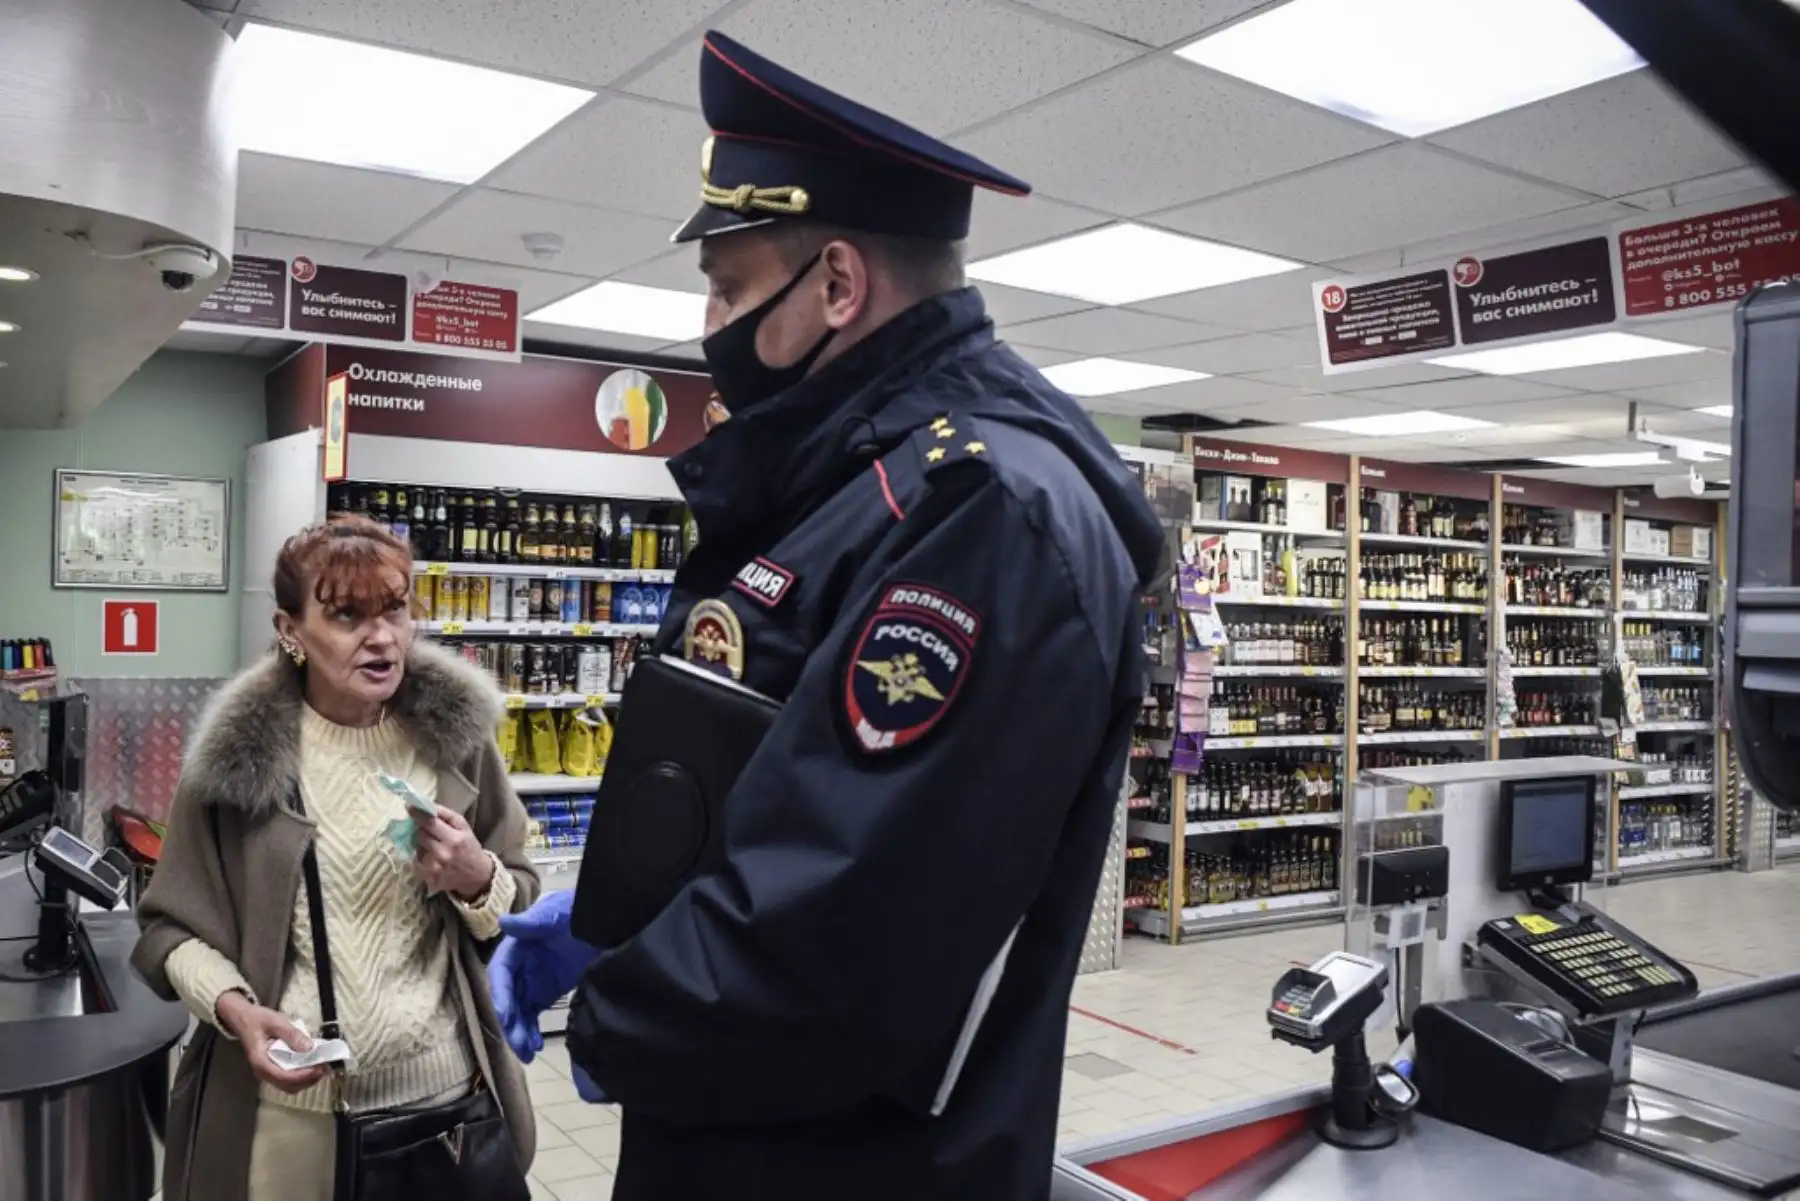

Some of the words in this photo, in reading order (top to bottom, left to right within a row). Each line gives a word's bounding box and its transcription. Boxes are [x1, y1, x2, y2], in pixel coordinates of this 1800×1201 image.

[1625, 229, 1680, 246] Больше
[1684, 223, 1708, 235] 3-х
[1712, 208, 1779, 228] человек
[1638, 234, 1707, 253] очереди?
[1712, 221, 1781, 242] Откроем
[1626, 239, 1751, 272] дополнительную
[1754, 230, 1799, 246] кассу
[1661, 258, 1742, 281] @ks5_bot
[301, 288, 385, 310] Улыбнитесь
[1469, 279, 1580, 307] Улыбнитесь
[1472, 308, 1502, 324] вас
[1505, 288, 1599, 318] снимают!
[1664, 296, 1675, 307] 8
[1679, 288, 1711, 304] 800
[1716, 283, 1747, 299] 555
[301, 306, 326, 317] вас
[328, 308, 396, 325] снимают!
[348, 362, 483, 391] Охлажденные
[348, 392, 425, 411] напитки
[891, 588, 977, 634] ПОЛИЦИЯ
[874, 624, 959, 673] РОССИЯ
